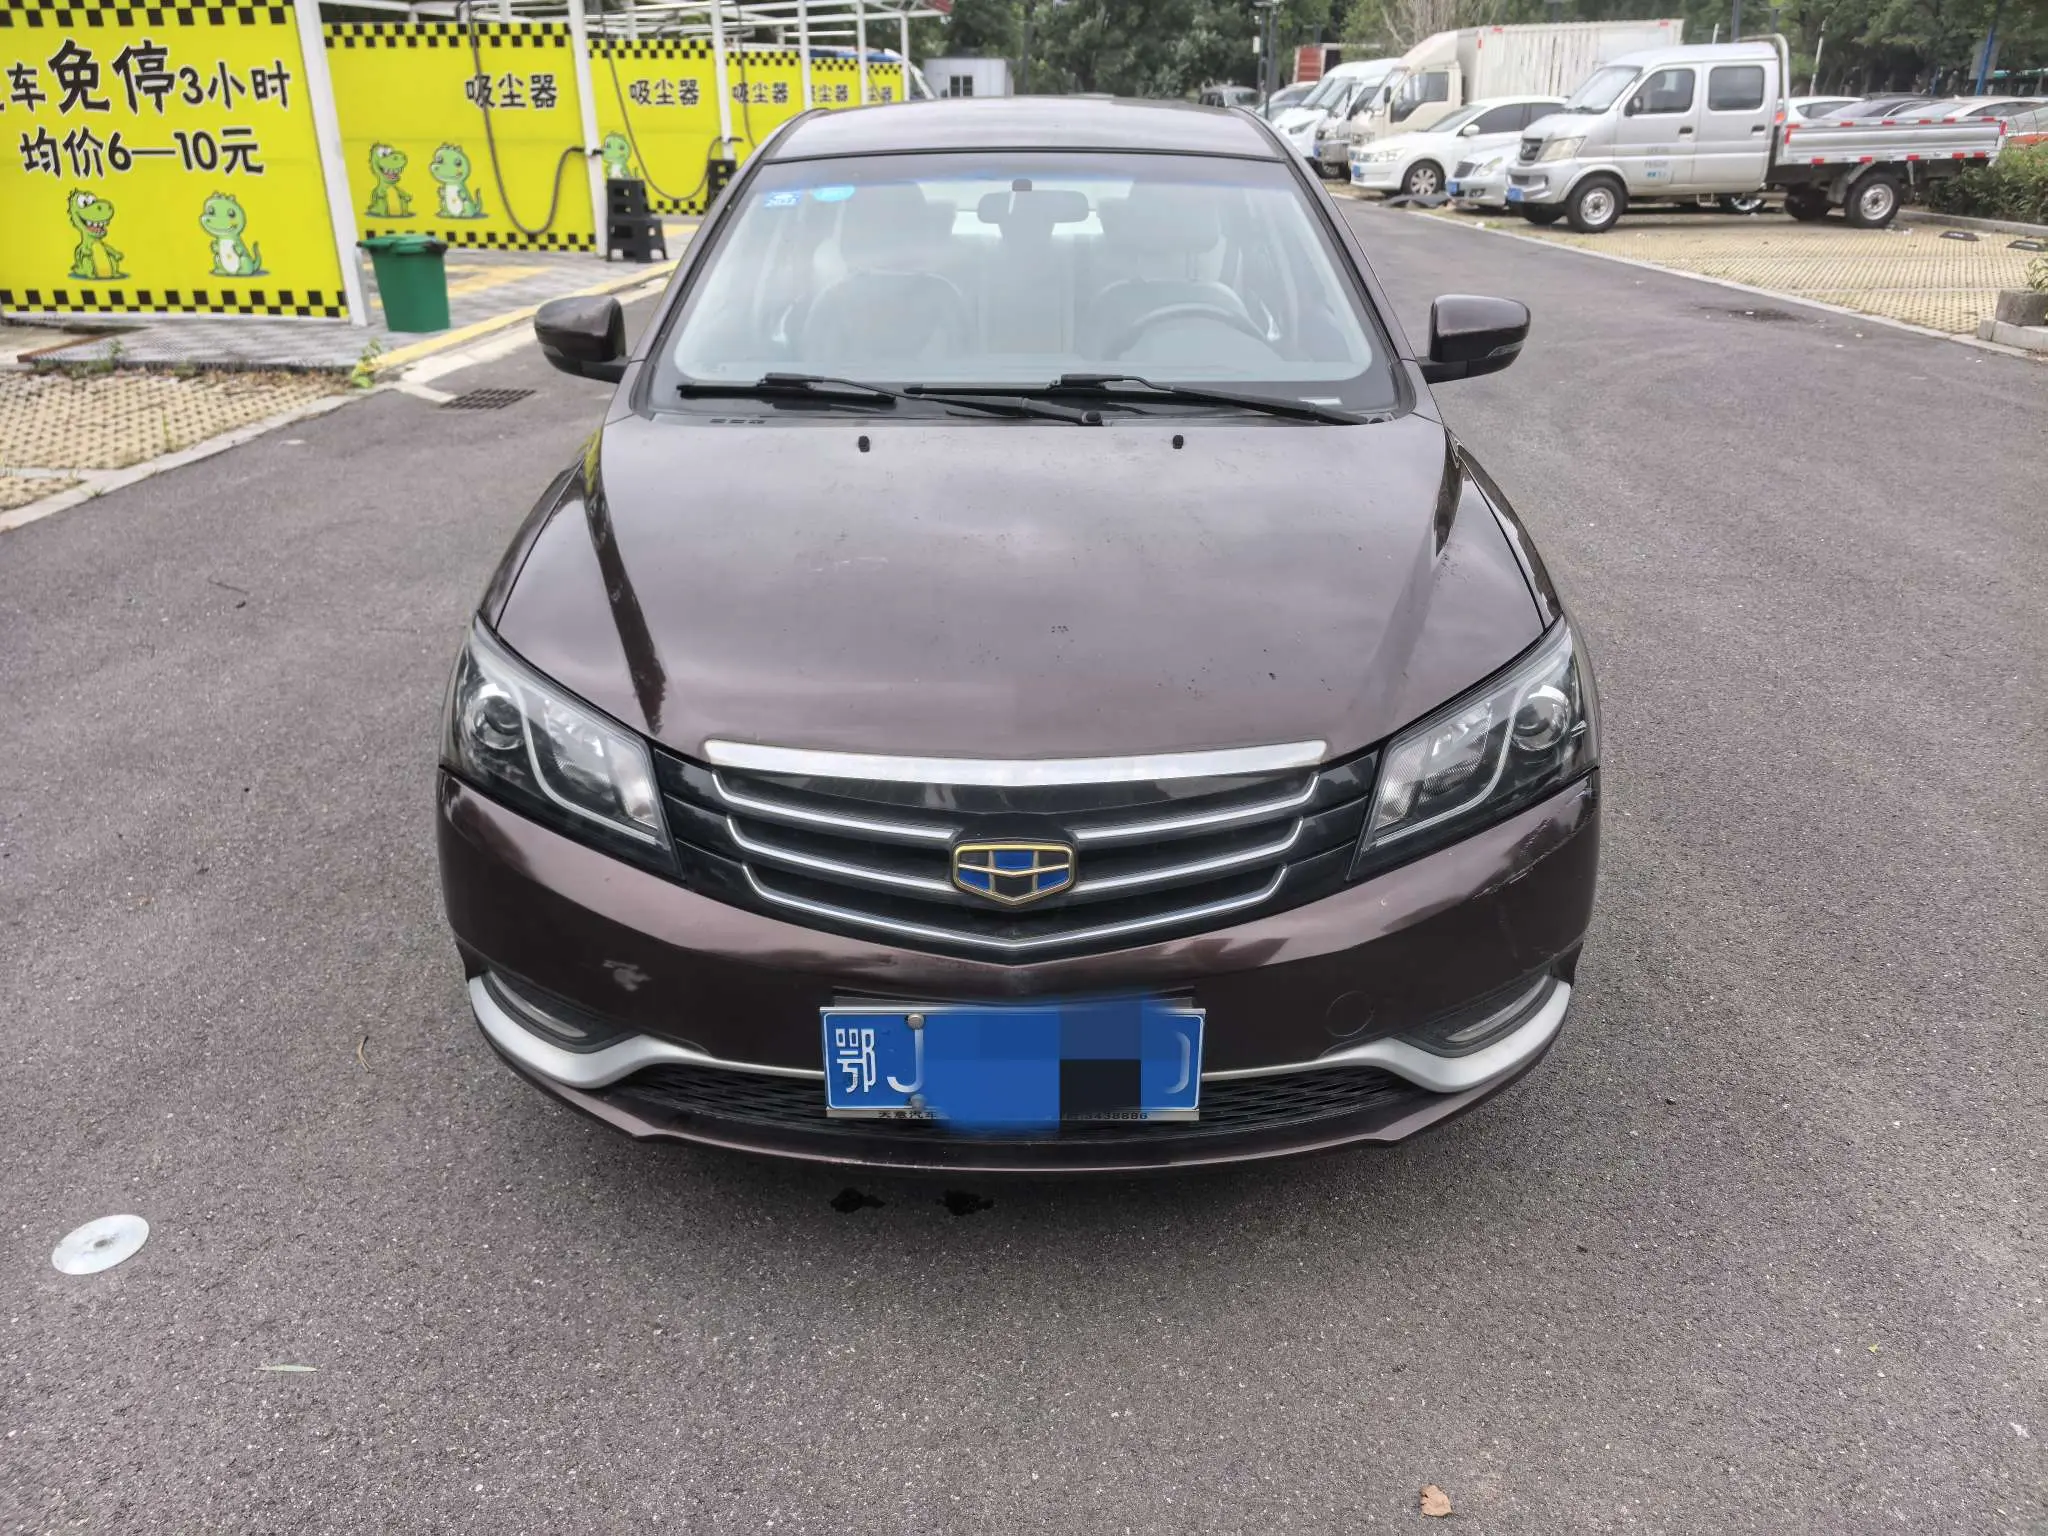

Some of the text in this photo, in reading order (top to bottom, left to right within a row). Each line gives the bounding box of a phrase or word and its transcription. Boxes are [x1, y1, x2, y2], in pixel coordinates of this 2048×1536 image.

[0, 39, 290, 114] 车免停3小时
[465, 73, 558, 109] 吸尘器
[629, 79, 699, 106] 吸尘器
[811, 84, 849, 103] 尘器
